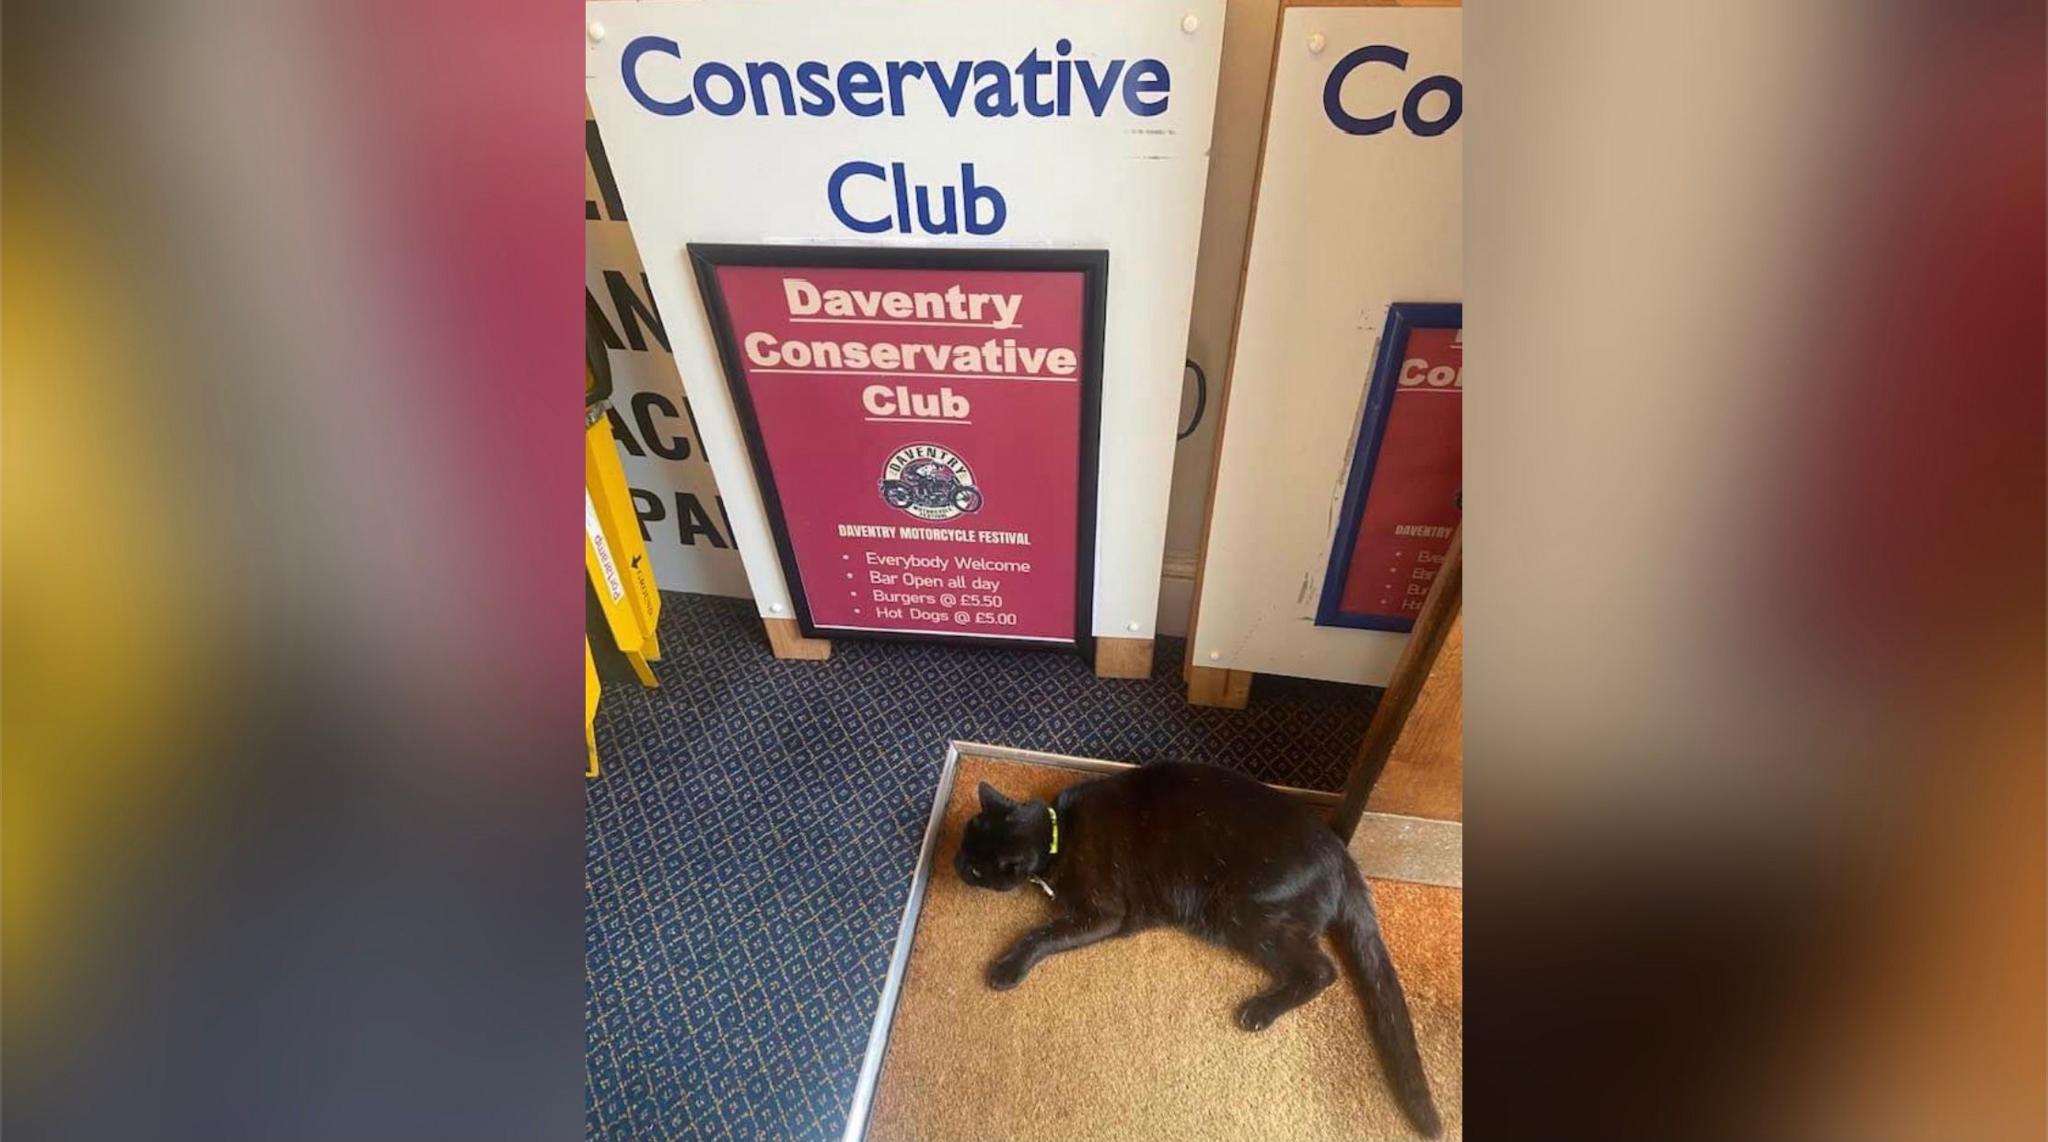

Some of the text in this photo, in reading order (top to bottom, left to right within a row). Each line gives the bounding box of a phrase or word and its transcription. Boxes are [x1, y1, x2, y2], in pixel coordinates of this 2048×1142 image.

[621, 36, 1171, 118] Conservative
[1323, 45, 1463, 137] Co
[827, 161, 1007, 236] Club
[783, 278, 1023, 330] Daventry
[744, 332, 1077, 375] Conservative
[1399, 358, 1463, 388] Co
[863, 385, 971, 419] Club
[606, 392, 710, 463] AC
[890, 446, 967, 475] DAVENTRY
[628, 487, 739, 551] PA
[838, 524, 1032, 545] DAVENTRY MOTORCYCLE FESTIVAL
[1395, 525, 1453, 539] DAVENTRY
[866, 552, 1032, 573] Everybody Welcome
[870, 571, 1000, 593] Bar Open all day
[873, 590, 1002, 608] Burgers @ £5.50
[876, 607, 1017, 625] Hot Dogs @ £5.00
